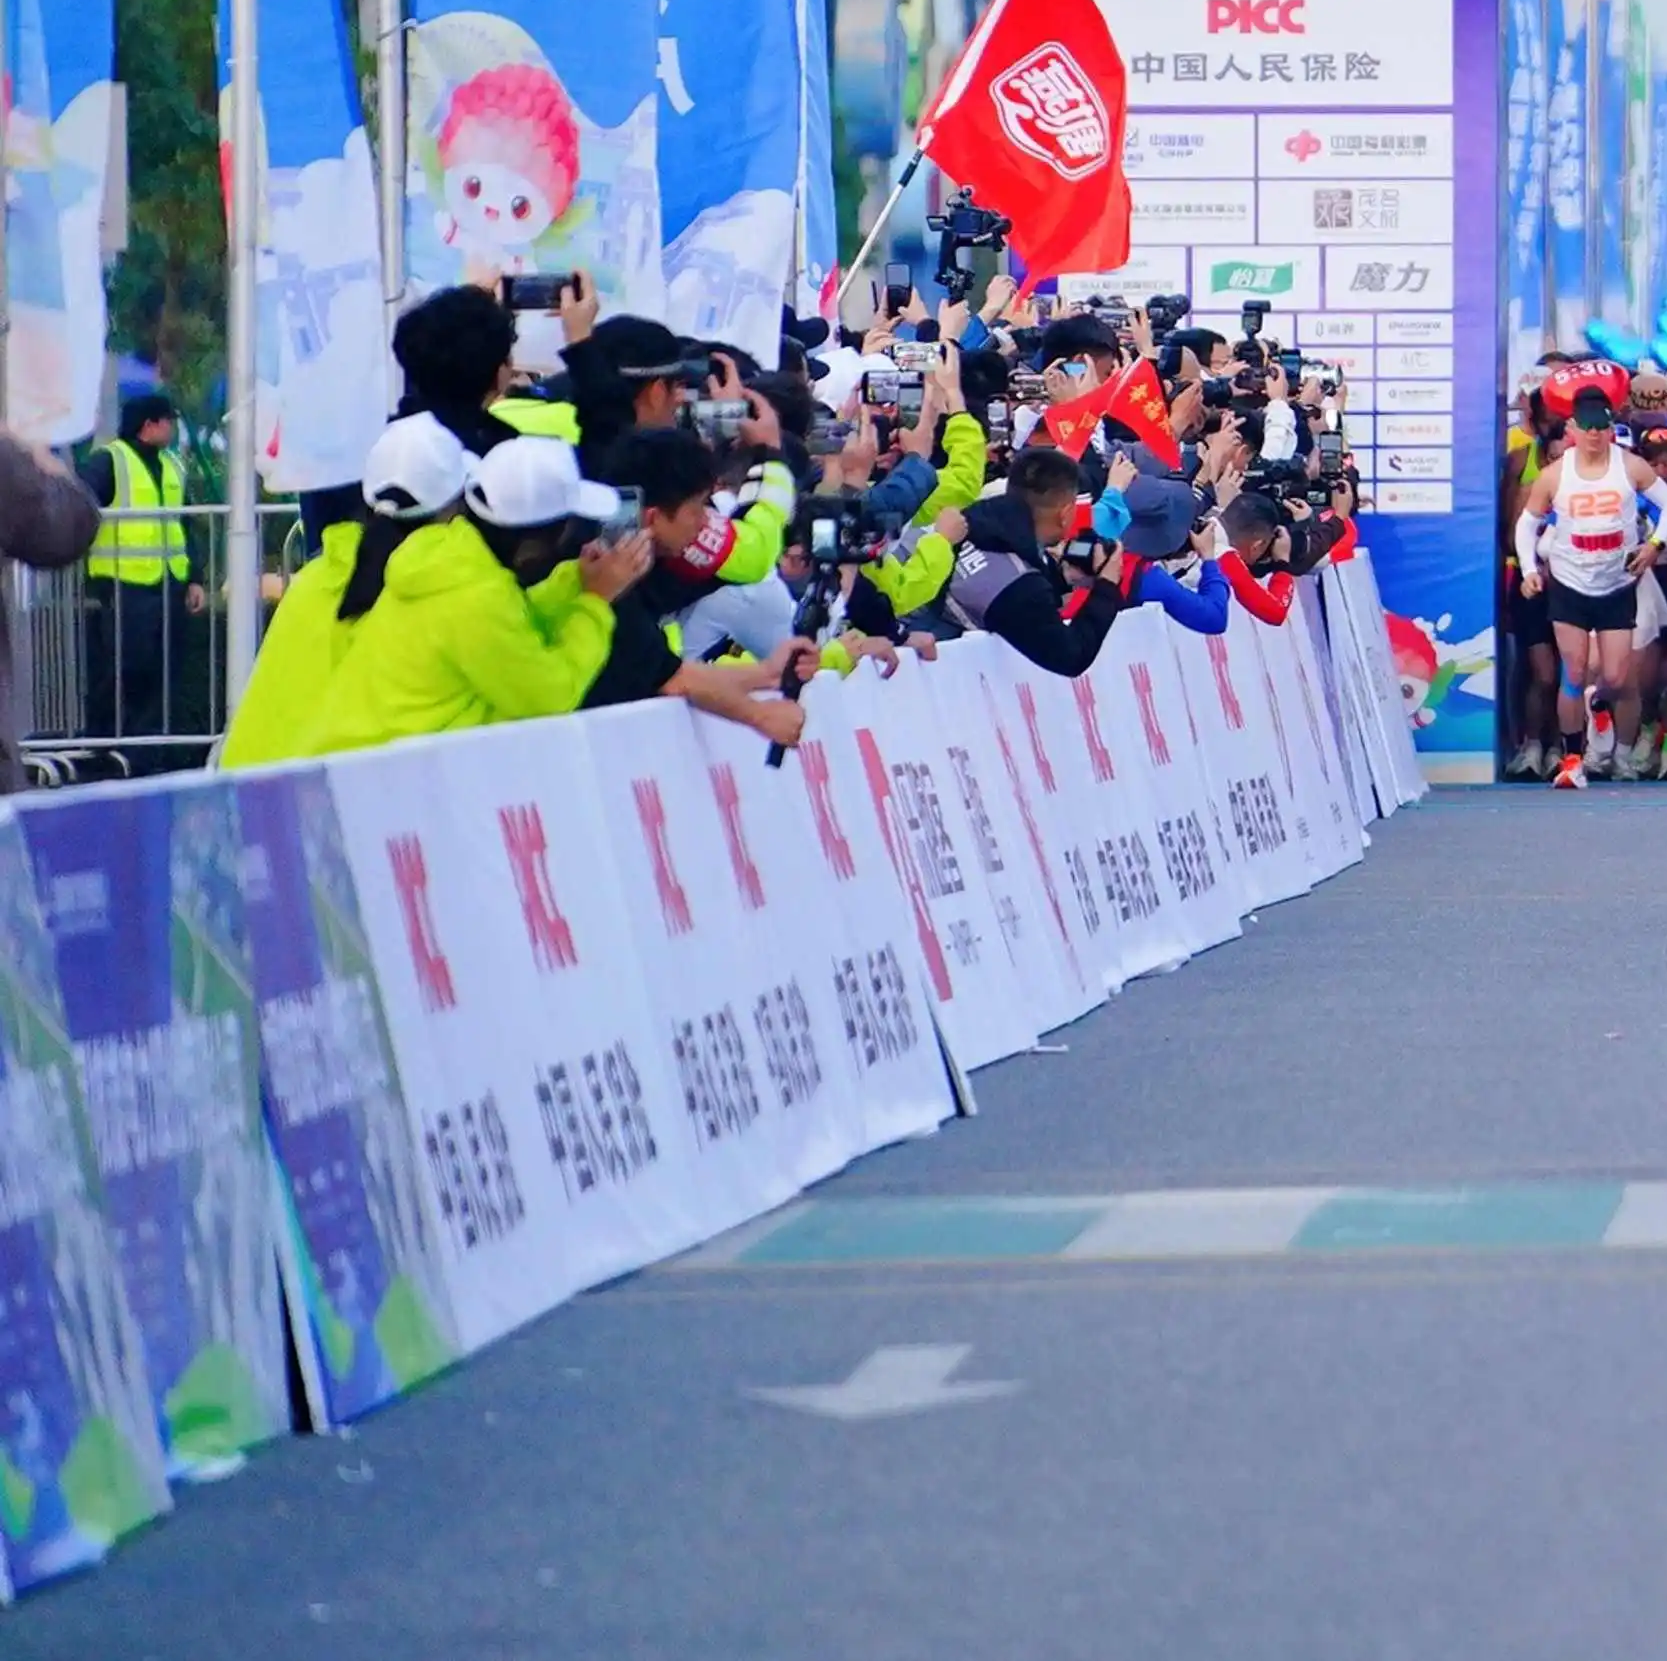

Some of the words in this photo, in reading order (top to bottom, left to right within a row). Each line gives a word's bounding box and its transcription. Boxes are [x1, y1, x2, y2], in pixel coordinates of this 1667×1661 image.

[1130, 51, 1381, 84] 中国人民保险
[1349, 262, 1430, 293] 魔力
[1554, 361, 1613, 385] 5:30
